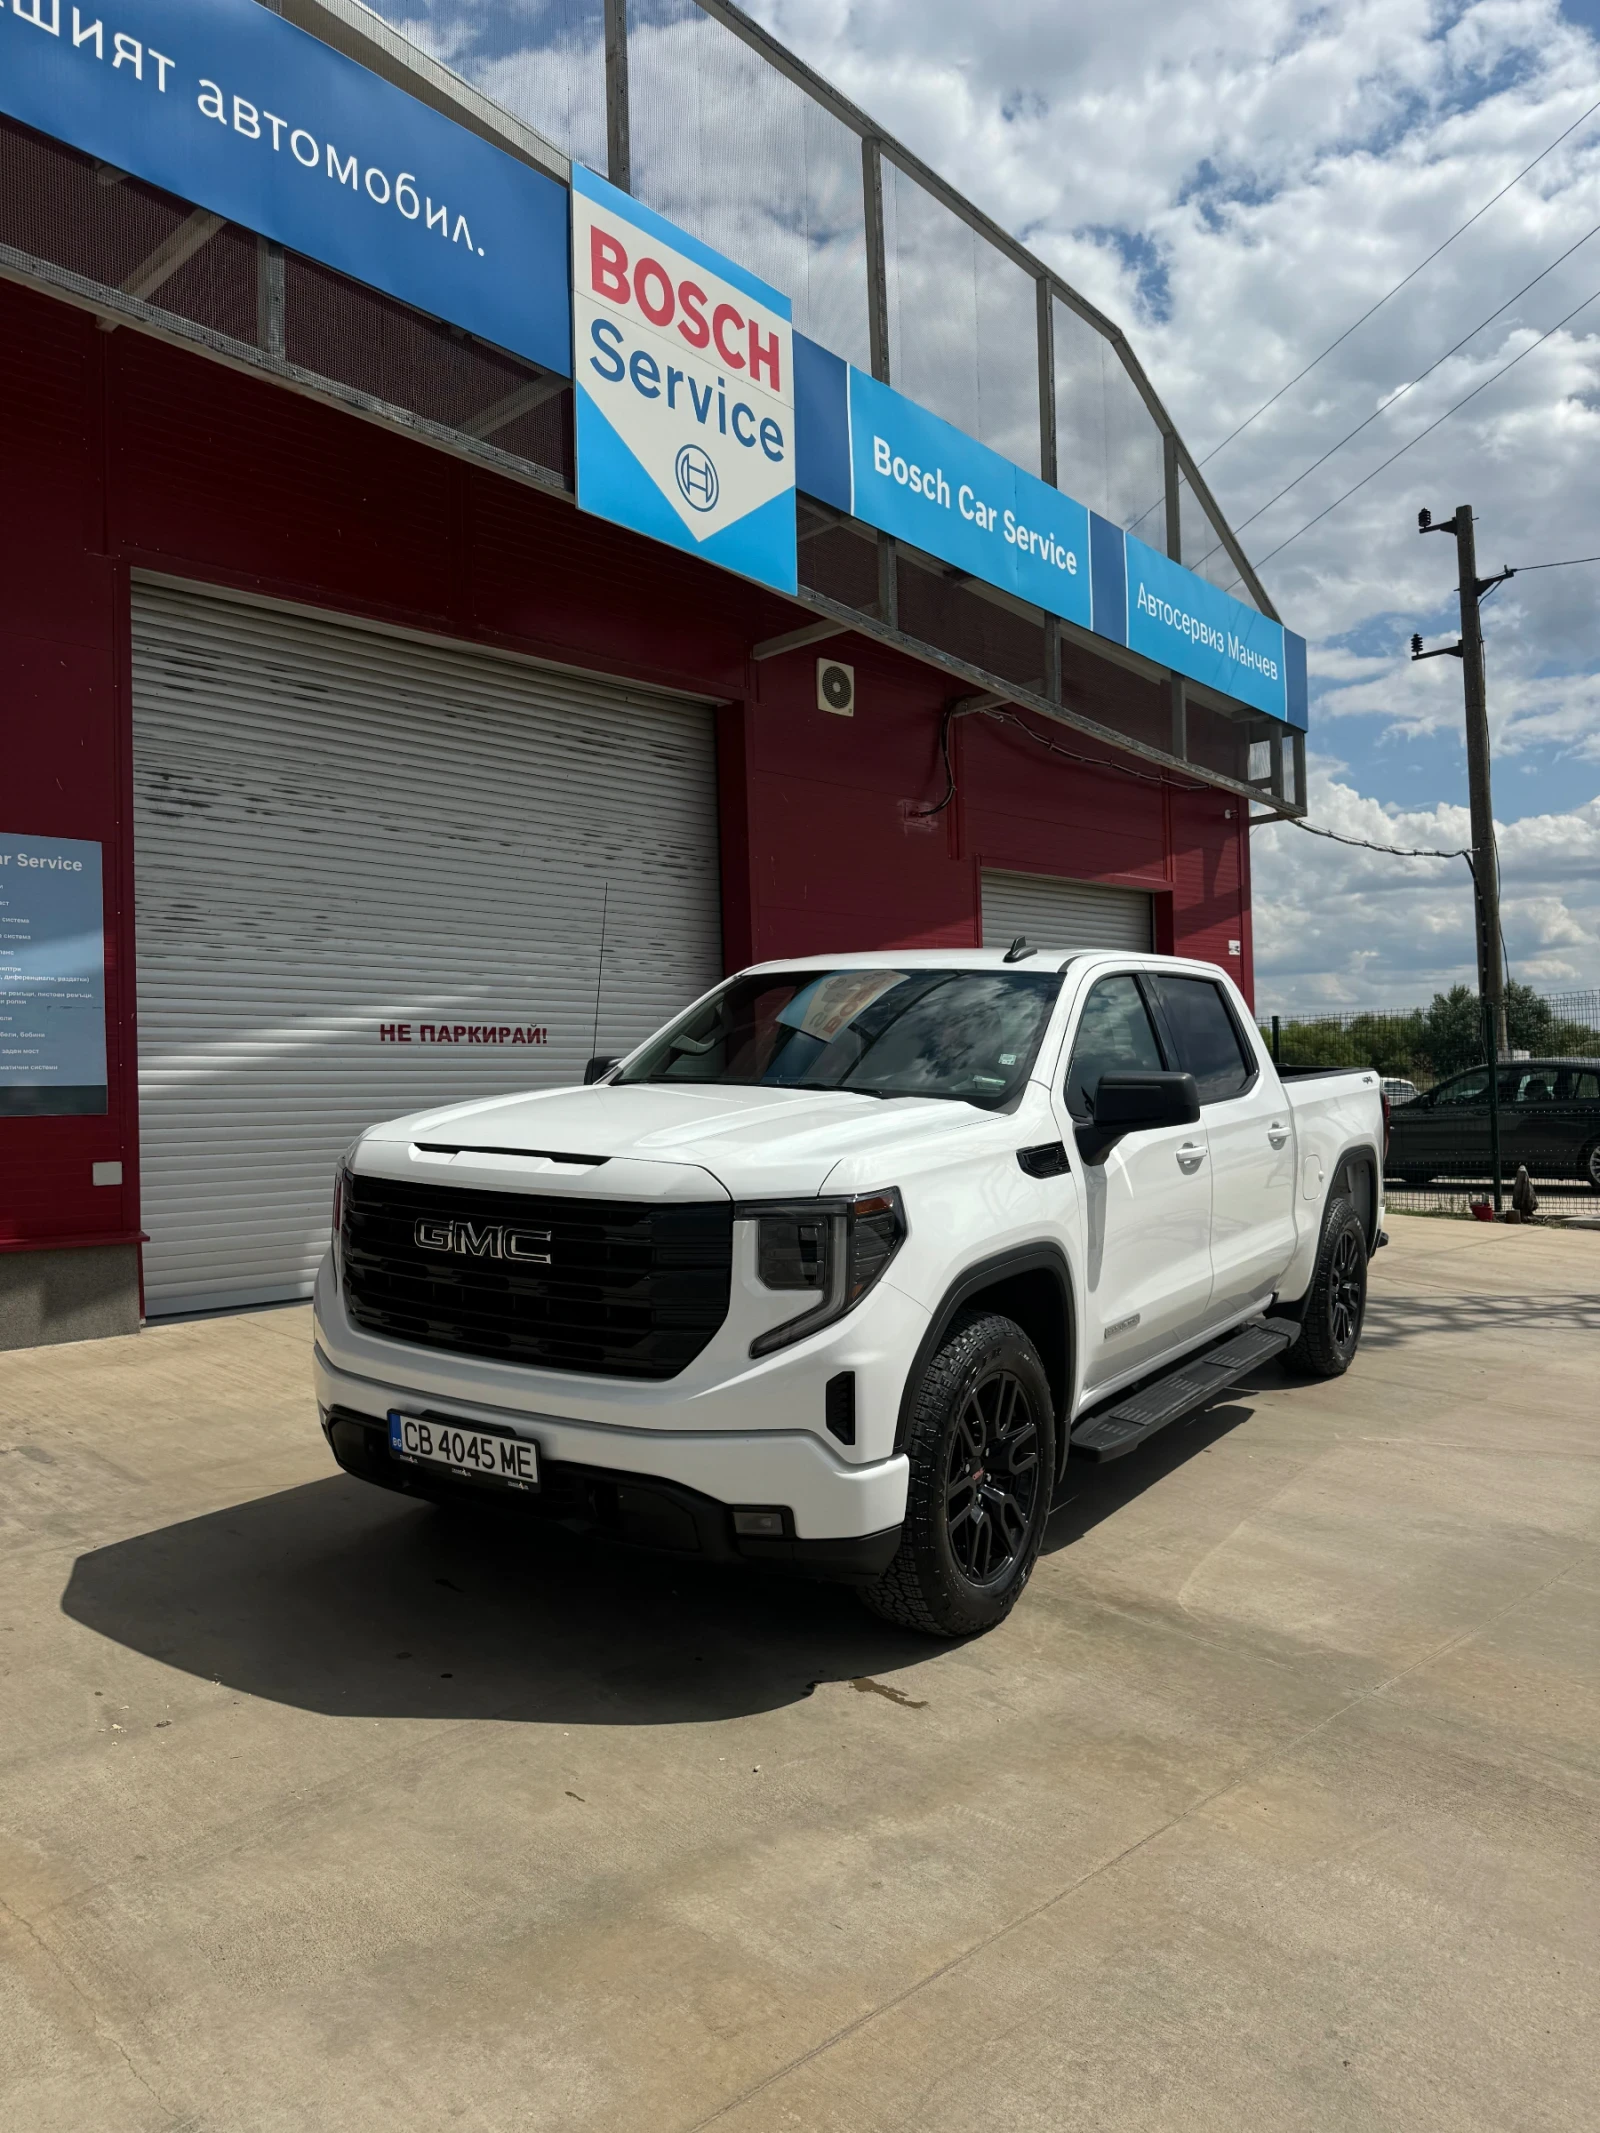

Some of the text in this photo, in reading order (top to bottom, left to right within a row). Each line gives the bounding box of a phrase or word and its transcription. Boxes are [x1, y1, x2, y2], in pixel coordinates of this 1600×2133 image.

[0, 0, 486, 257] шият автомобил.
[590, 224, 781, 393] BOSCH
[589, 318, 785, 463] Service
[873, 434, 1078, 576] Bosch Car Service
[1136, 581, 1278, 681] Автосервиз Манчев
[17, 853, 83, 872] Service
[380, 1023, 548, 1045] НЕ ПАРКИРАЙ!
[413, 1217, 552, 1265] GMC
[392, 1437, 402, 1448] BG
[404, 1421, 534, 1480] CB 4045 ME
